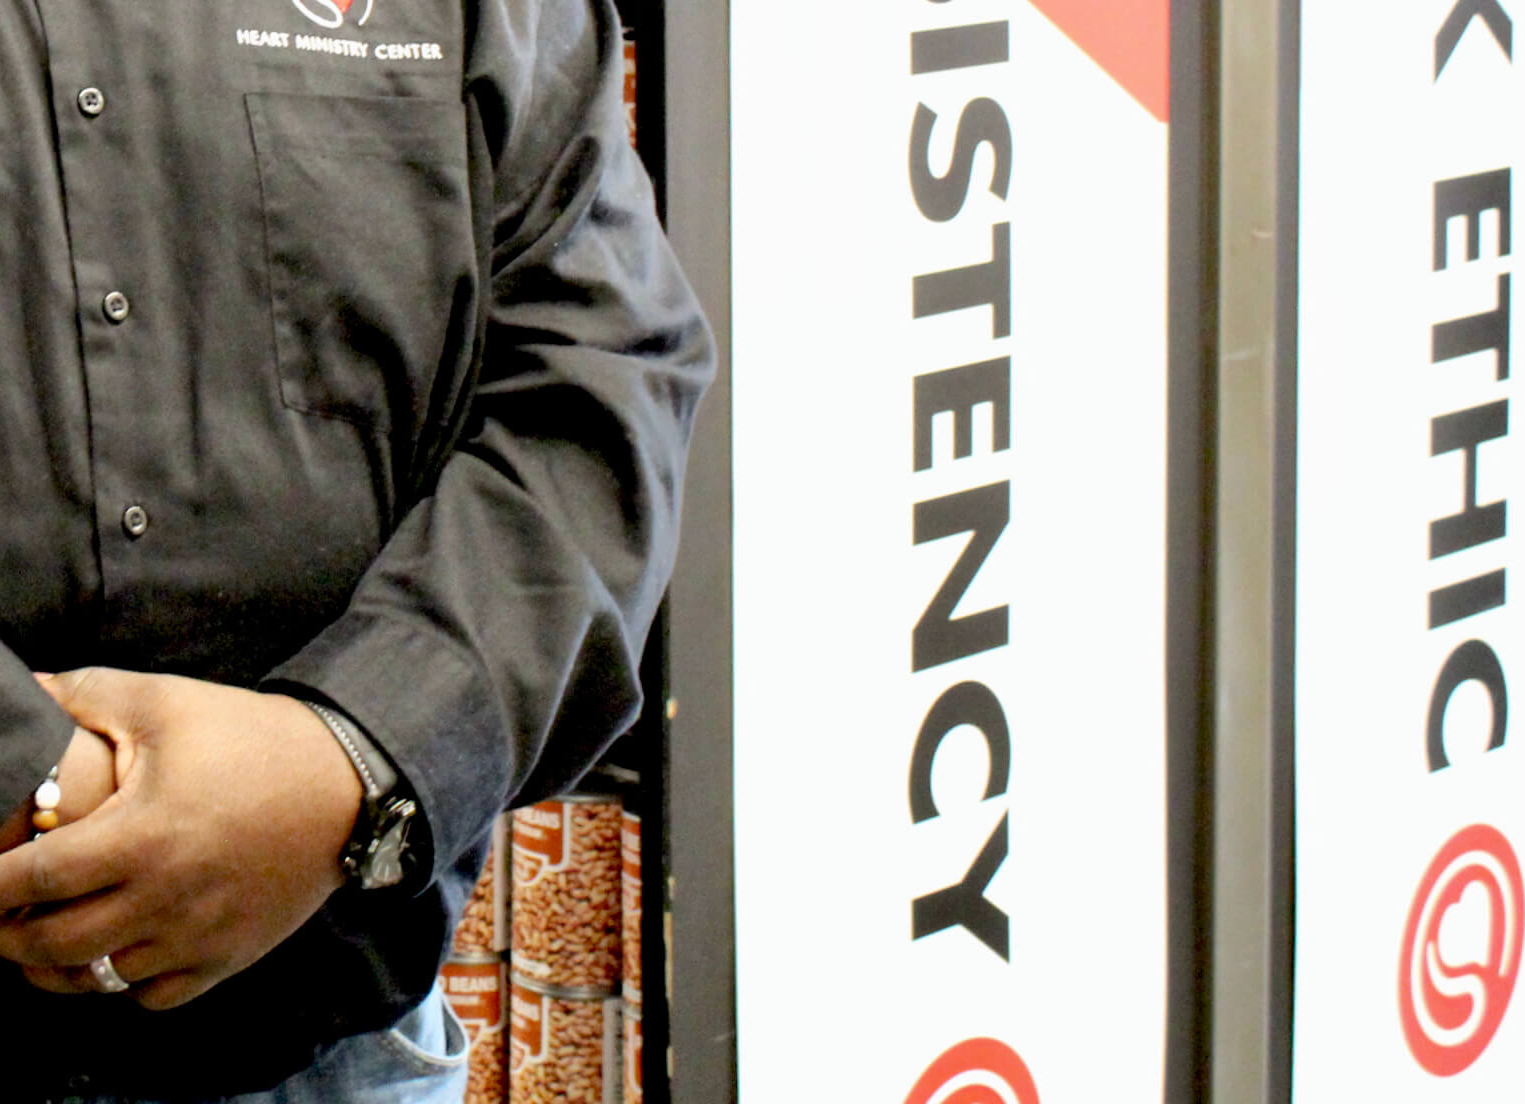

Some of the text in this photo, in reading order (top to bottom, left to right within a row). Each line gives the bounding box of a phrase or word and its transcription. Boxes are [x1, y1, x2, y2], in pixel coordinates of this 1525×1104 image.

[236, 29, 443, 60] HEART MINISTRY CENTER
[1426, 167, 1512, 772] ETHIC
